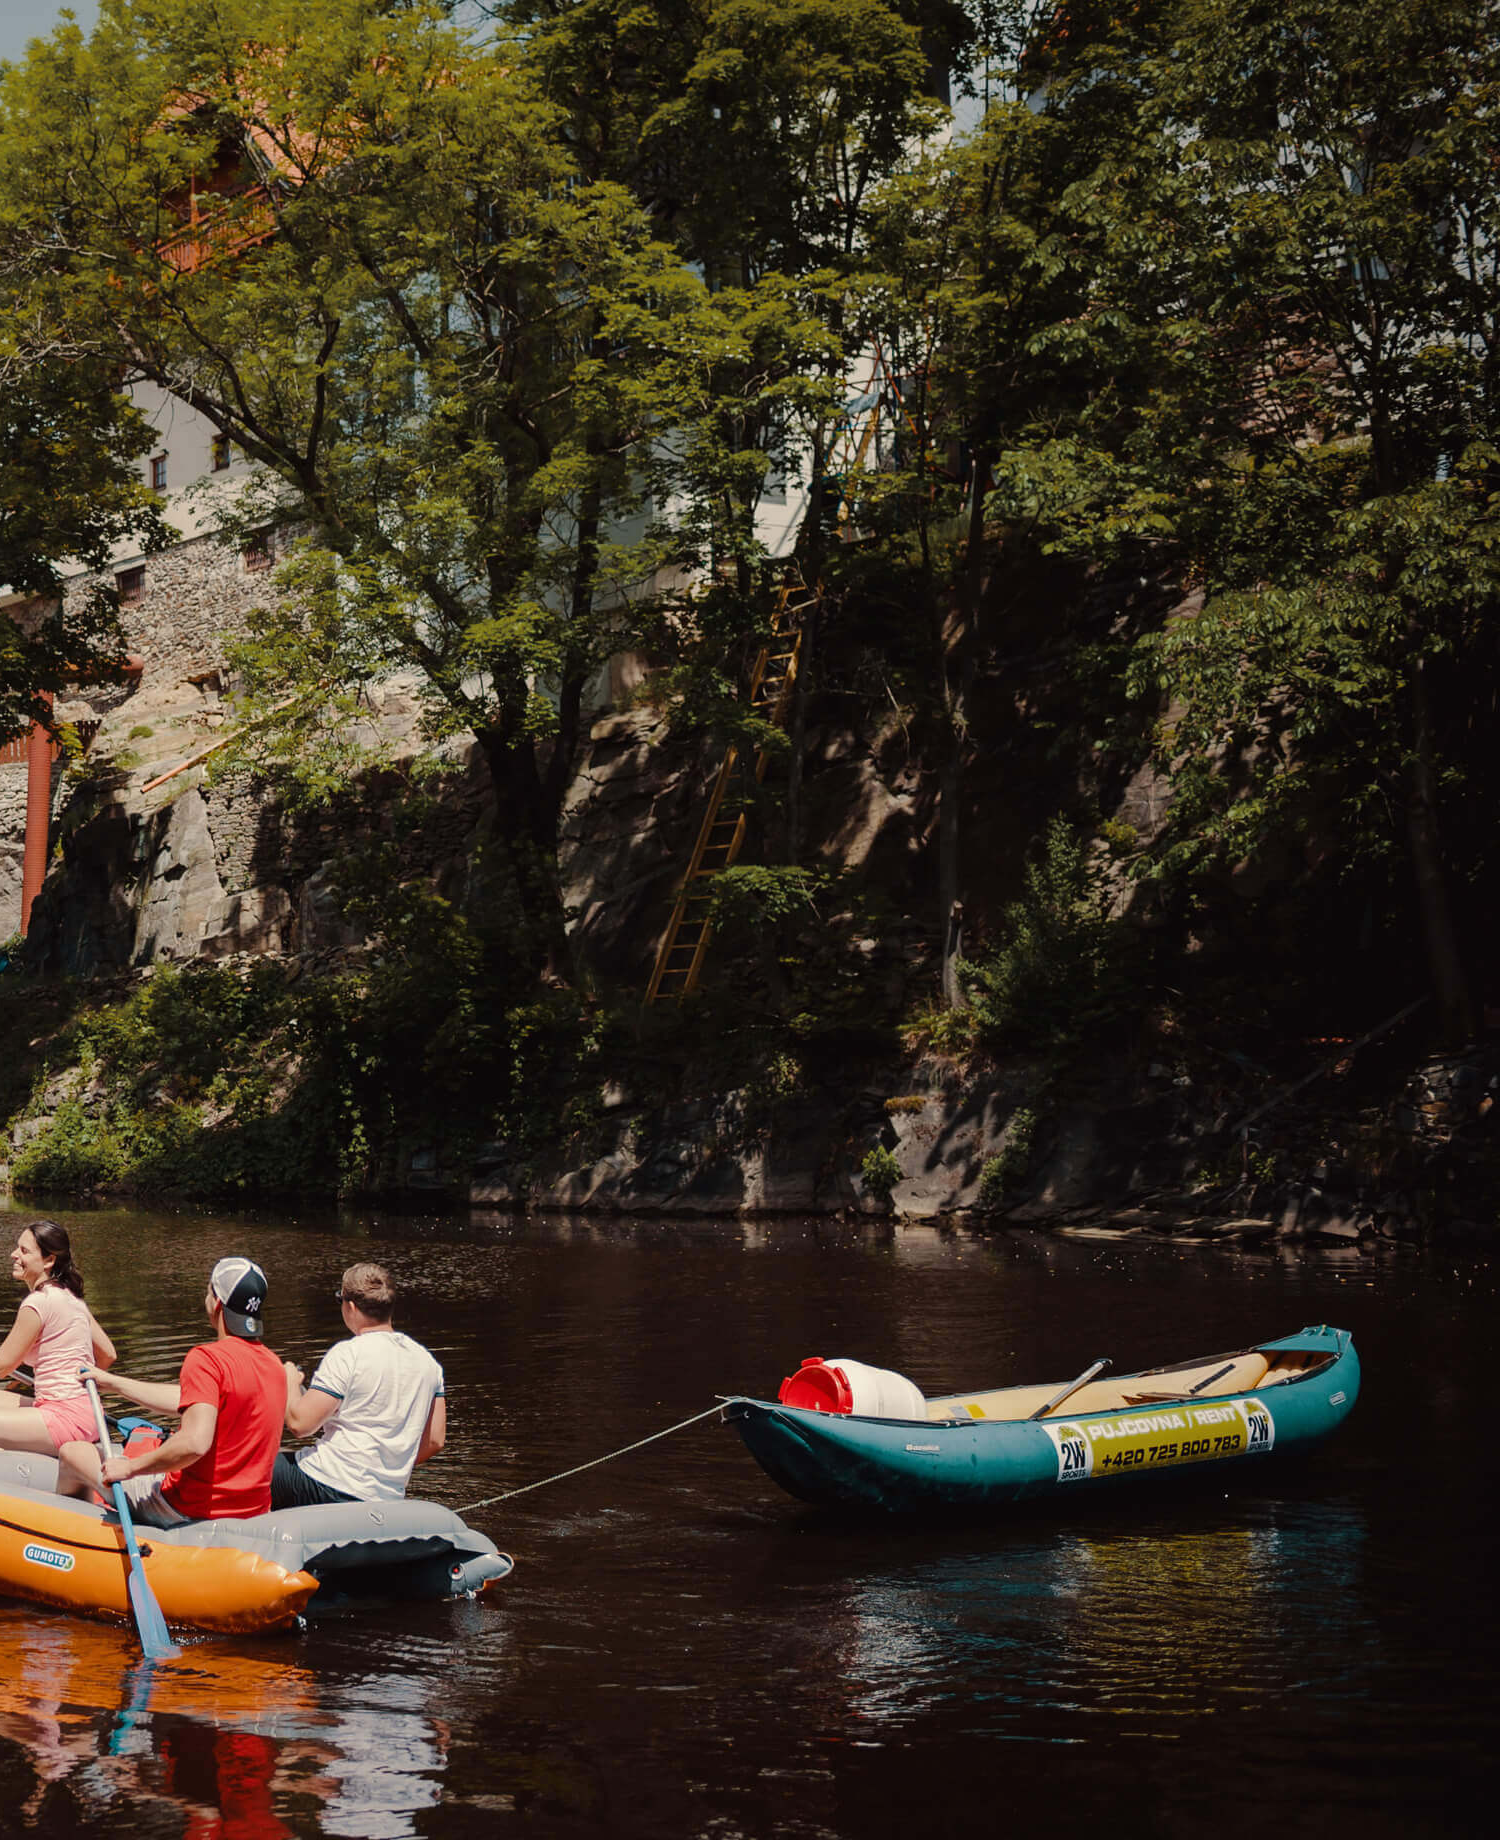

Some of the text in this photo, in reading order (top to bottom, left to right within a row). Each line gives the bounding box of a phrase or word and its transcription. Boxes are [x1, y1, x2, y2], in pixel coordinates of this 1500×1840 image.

[1193, 1407, 1237, 1425] RENT
[1249, 1415, 1269, 1443] 2W
[1061, 1440, 1086, 1470] 2W
[1102, 1435, 1241, 1467] +420 725 800 783
[1061, 1470, 1086, 1480] SPORTS
[27, 1548, 72, 1569] GUMOTEX
